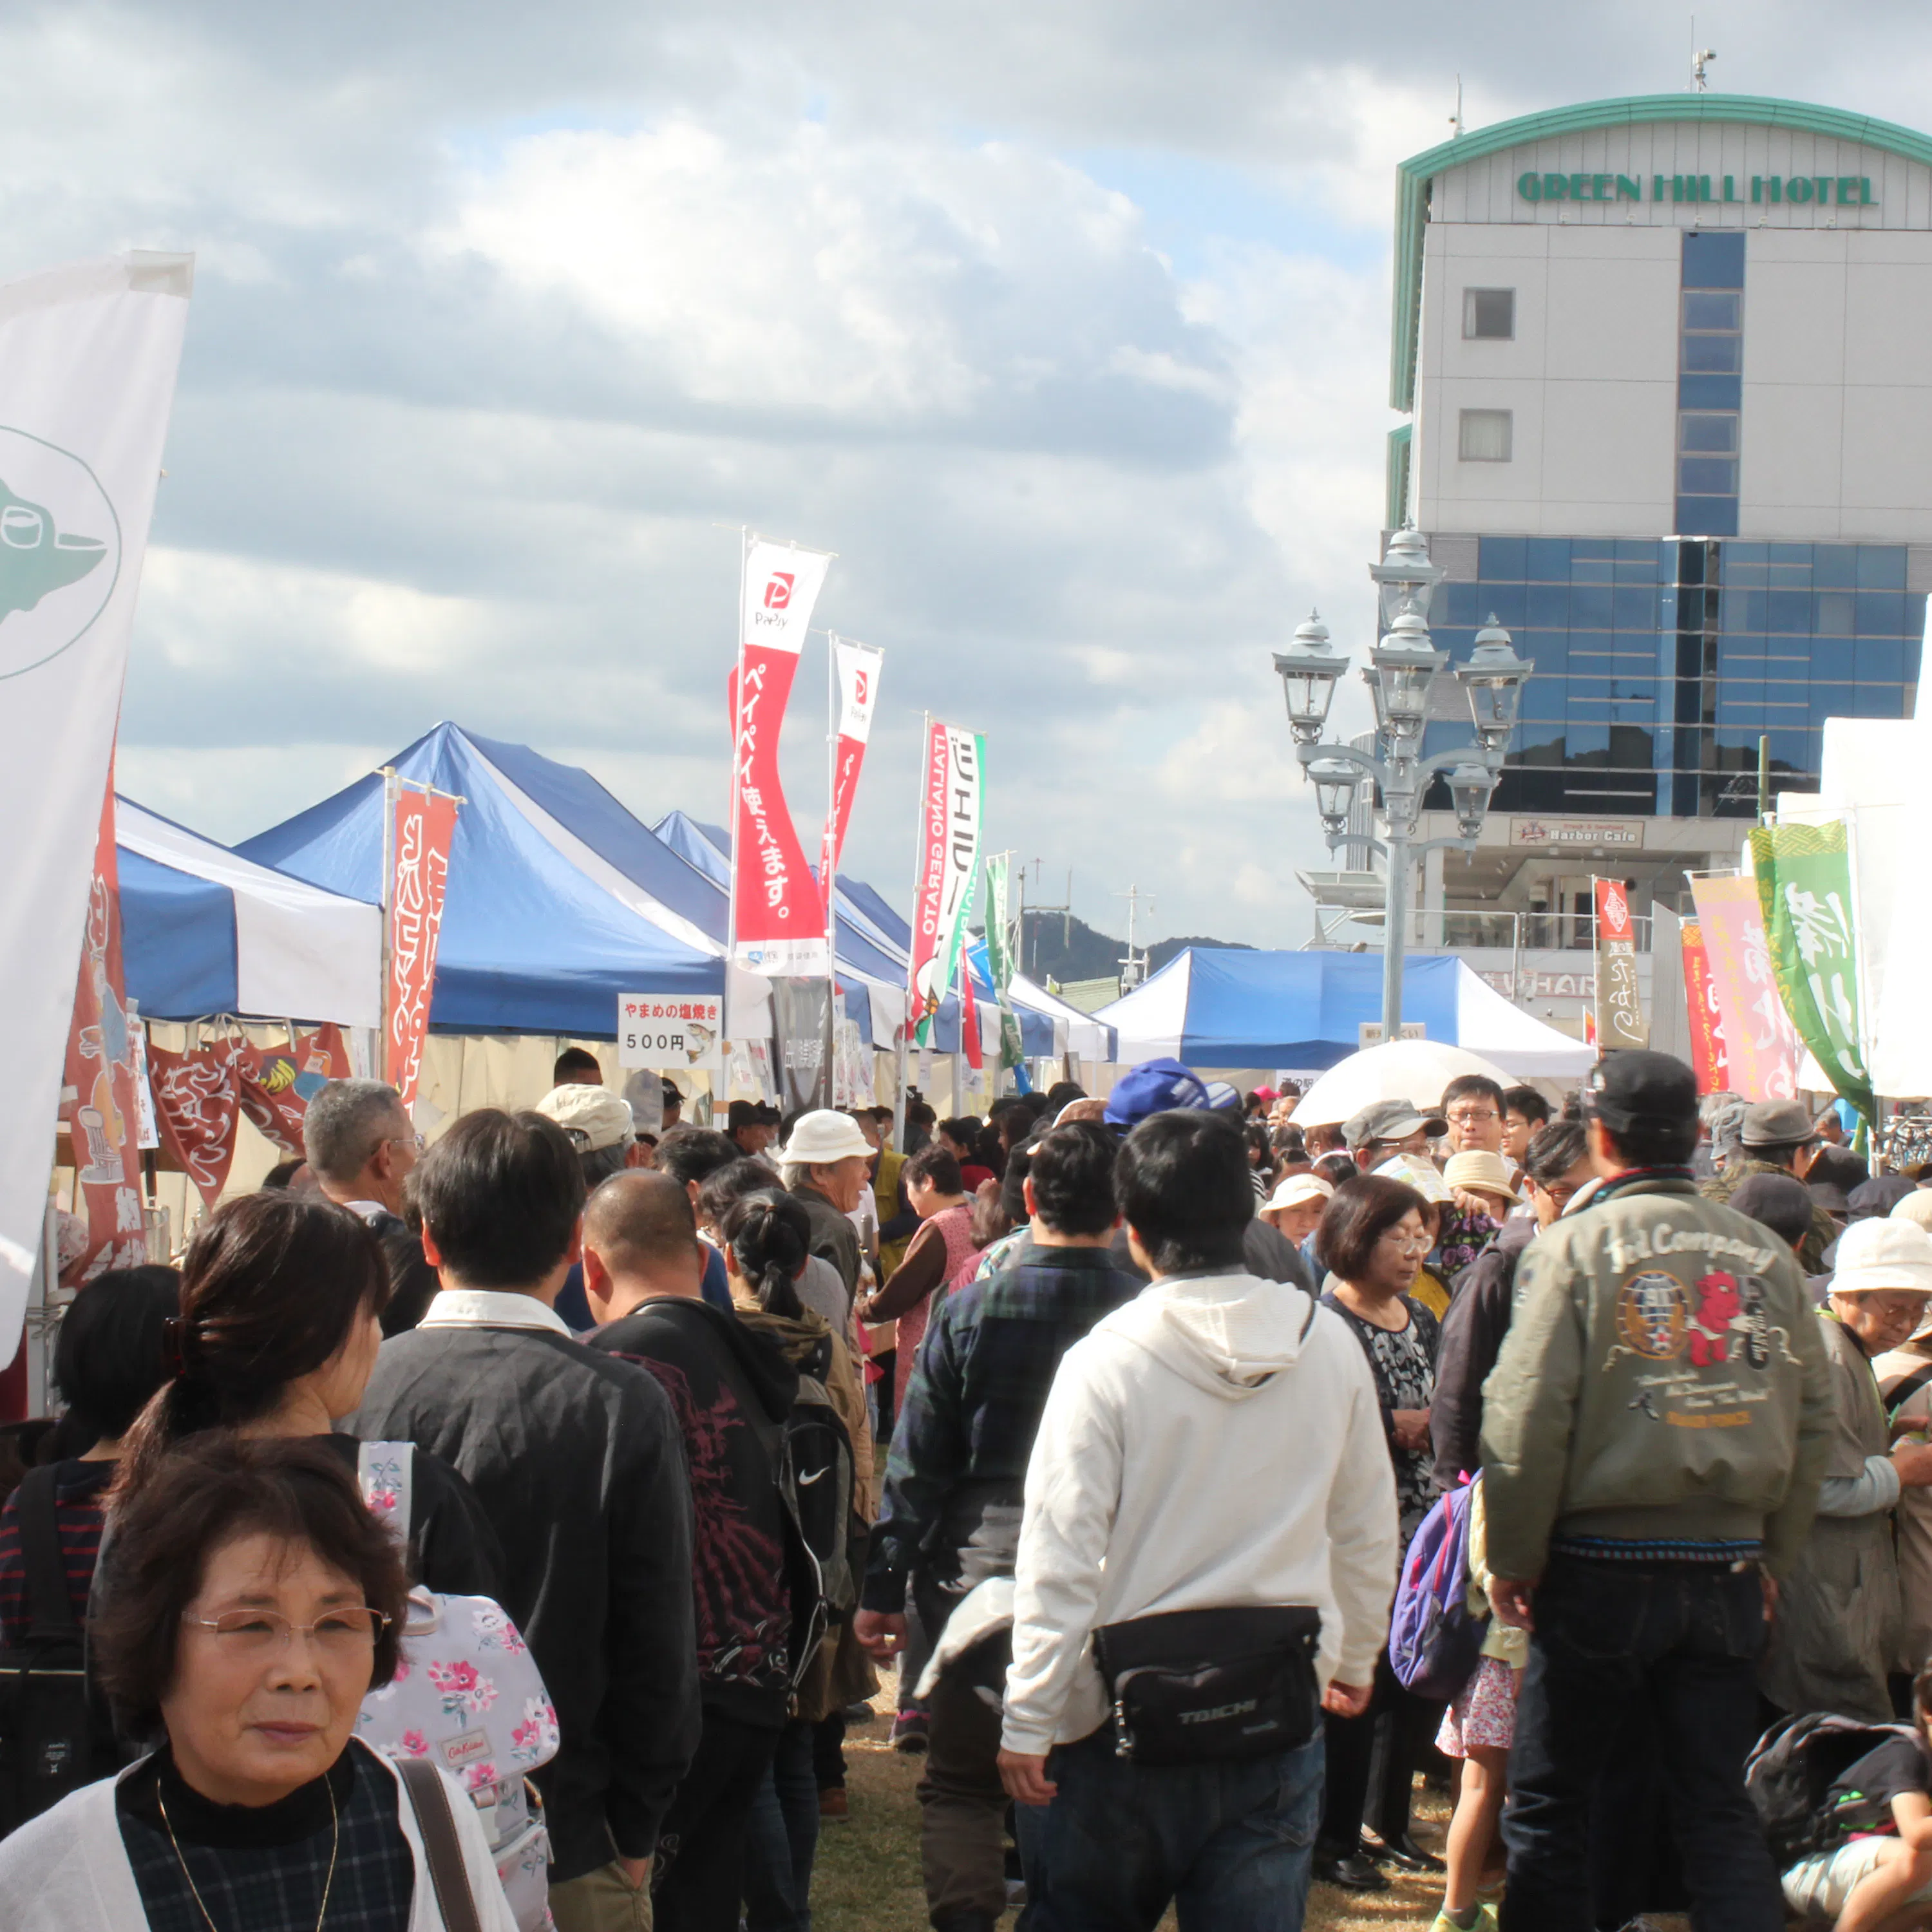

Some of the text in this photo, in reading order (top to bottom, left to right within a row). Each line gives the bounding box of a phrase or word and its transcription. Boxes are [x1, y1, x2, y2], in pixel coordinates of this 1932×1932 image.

[1517, 171, 1879, 206] GREEN HILL HOTEL
[1549, 829, 1636, 842] Harbor Cafe
[625, 1002, 717, 1020] やまめの塩焼き
[626, 1034, 684, 1051] 500円
